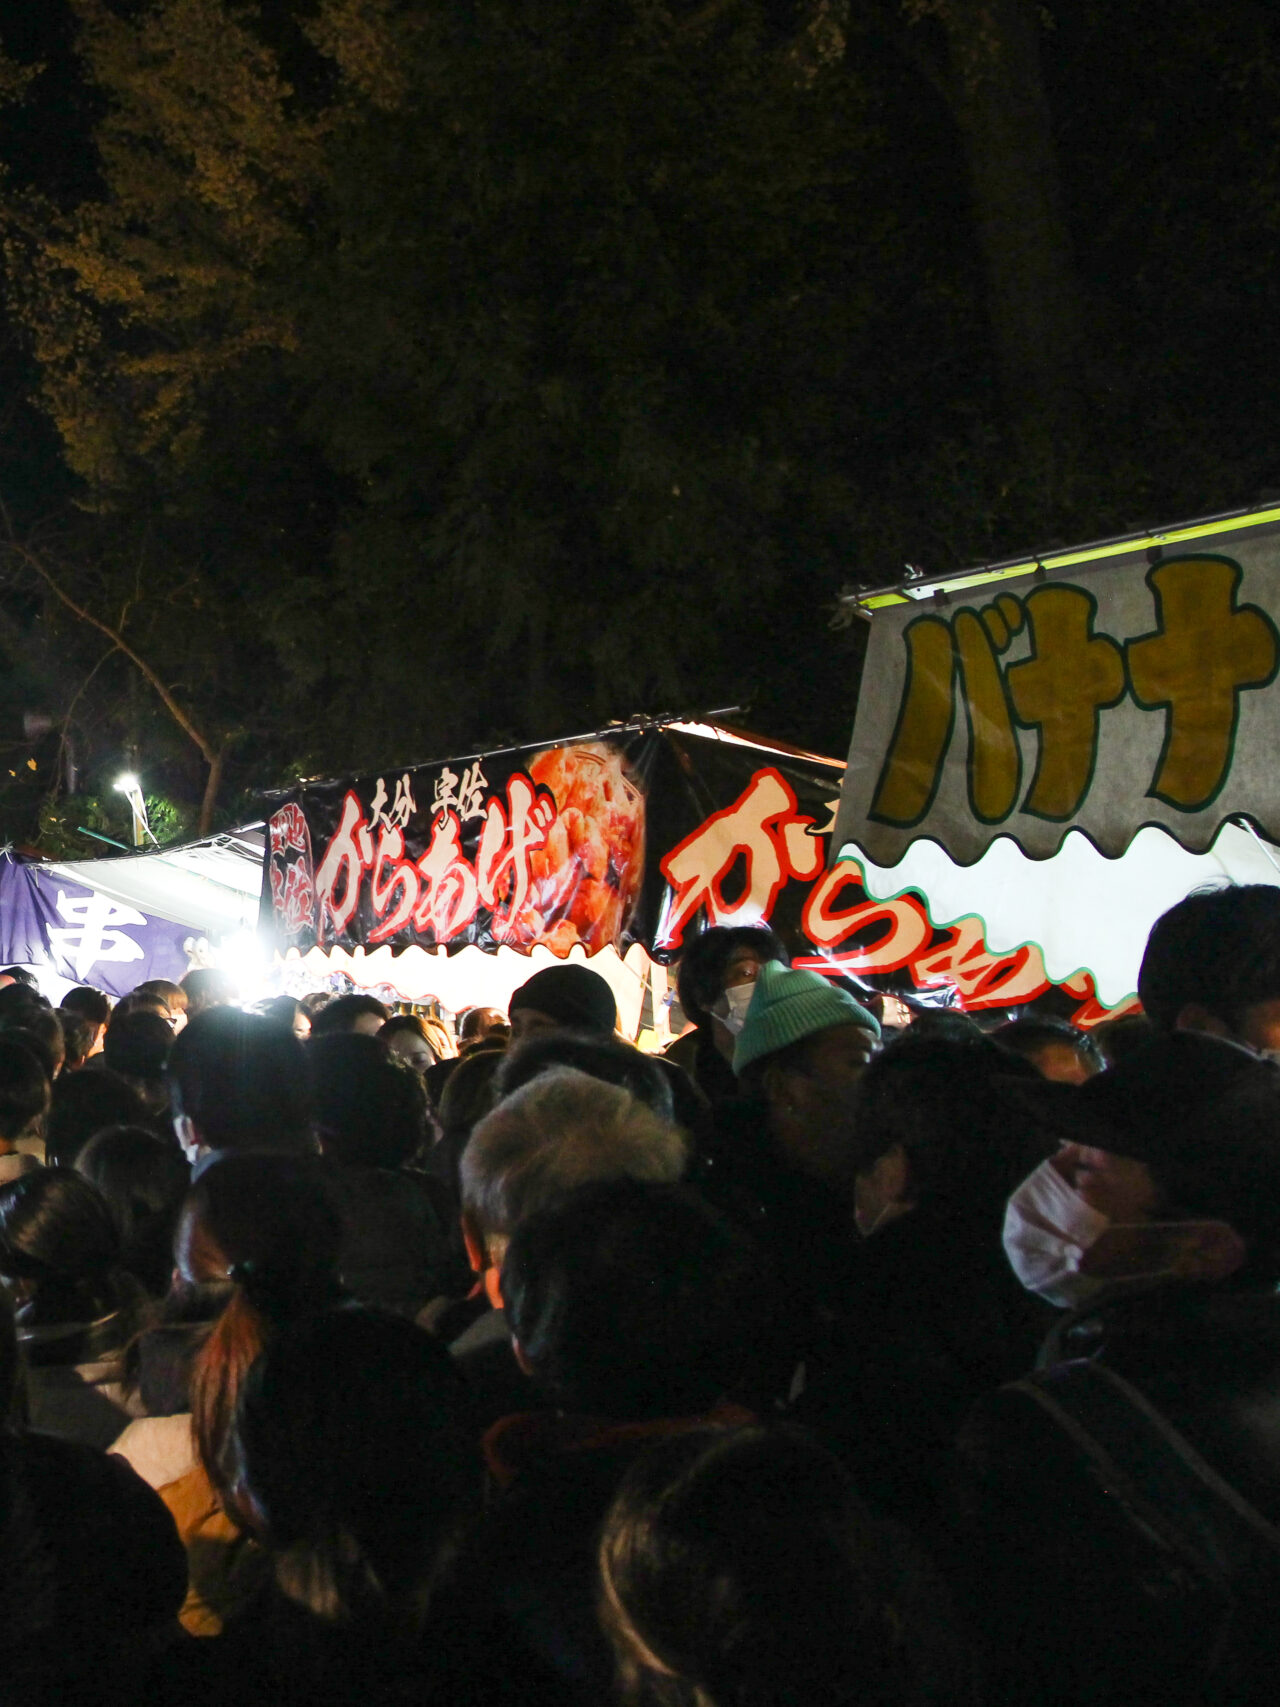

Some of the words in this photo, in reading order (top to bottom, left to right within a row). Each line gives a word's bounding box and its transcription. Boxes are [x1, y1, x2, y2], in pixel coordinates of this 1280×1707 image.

[367, 773, 417, 833] 大分
[430, 762, 489, 831] 宇佐
[868, 553, 1279, 827] バナナ
[316, 772, 557, 945] からあげ
[660, 767, 1145, 1032] からあ
